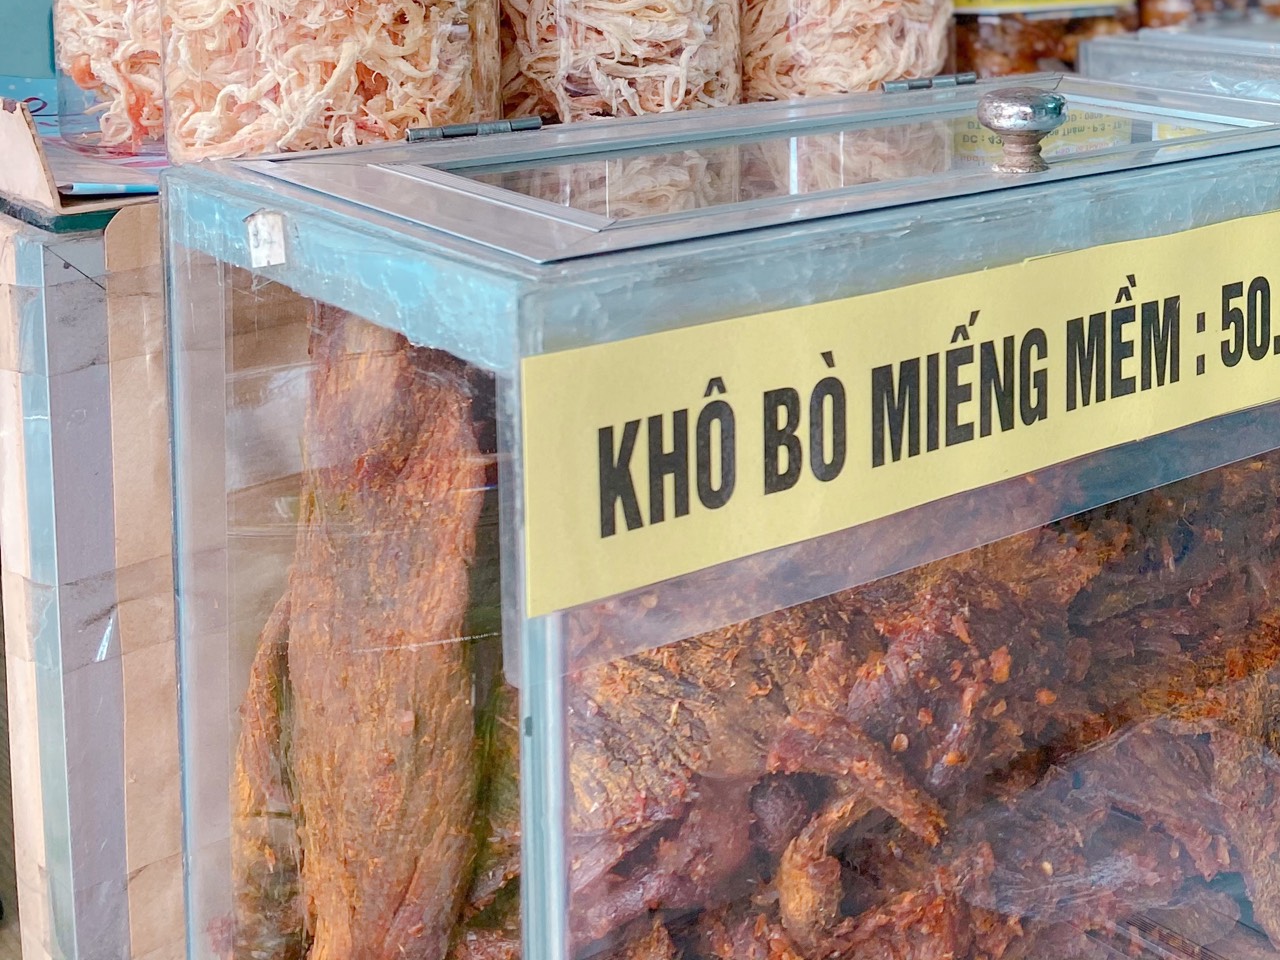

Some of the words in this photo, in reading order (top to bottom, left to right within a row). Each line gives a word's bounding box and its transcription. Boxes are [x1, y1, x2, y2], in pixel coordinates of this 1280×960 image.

[599, 375, 735, 540] KHÔ
[763, 351, 846, 497] BÒ
[870, 308, 1049, 471] MIẾNG
[1065, 273, 1181, 413] MỀM
